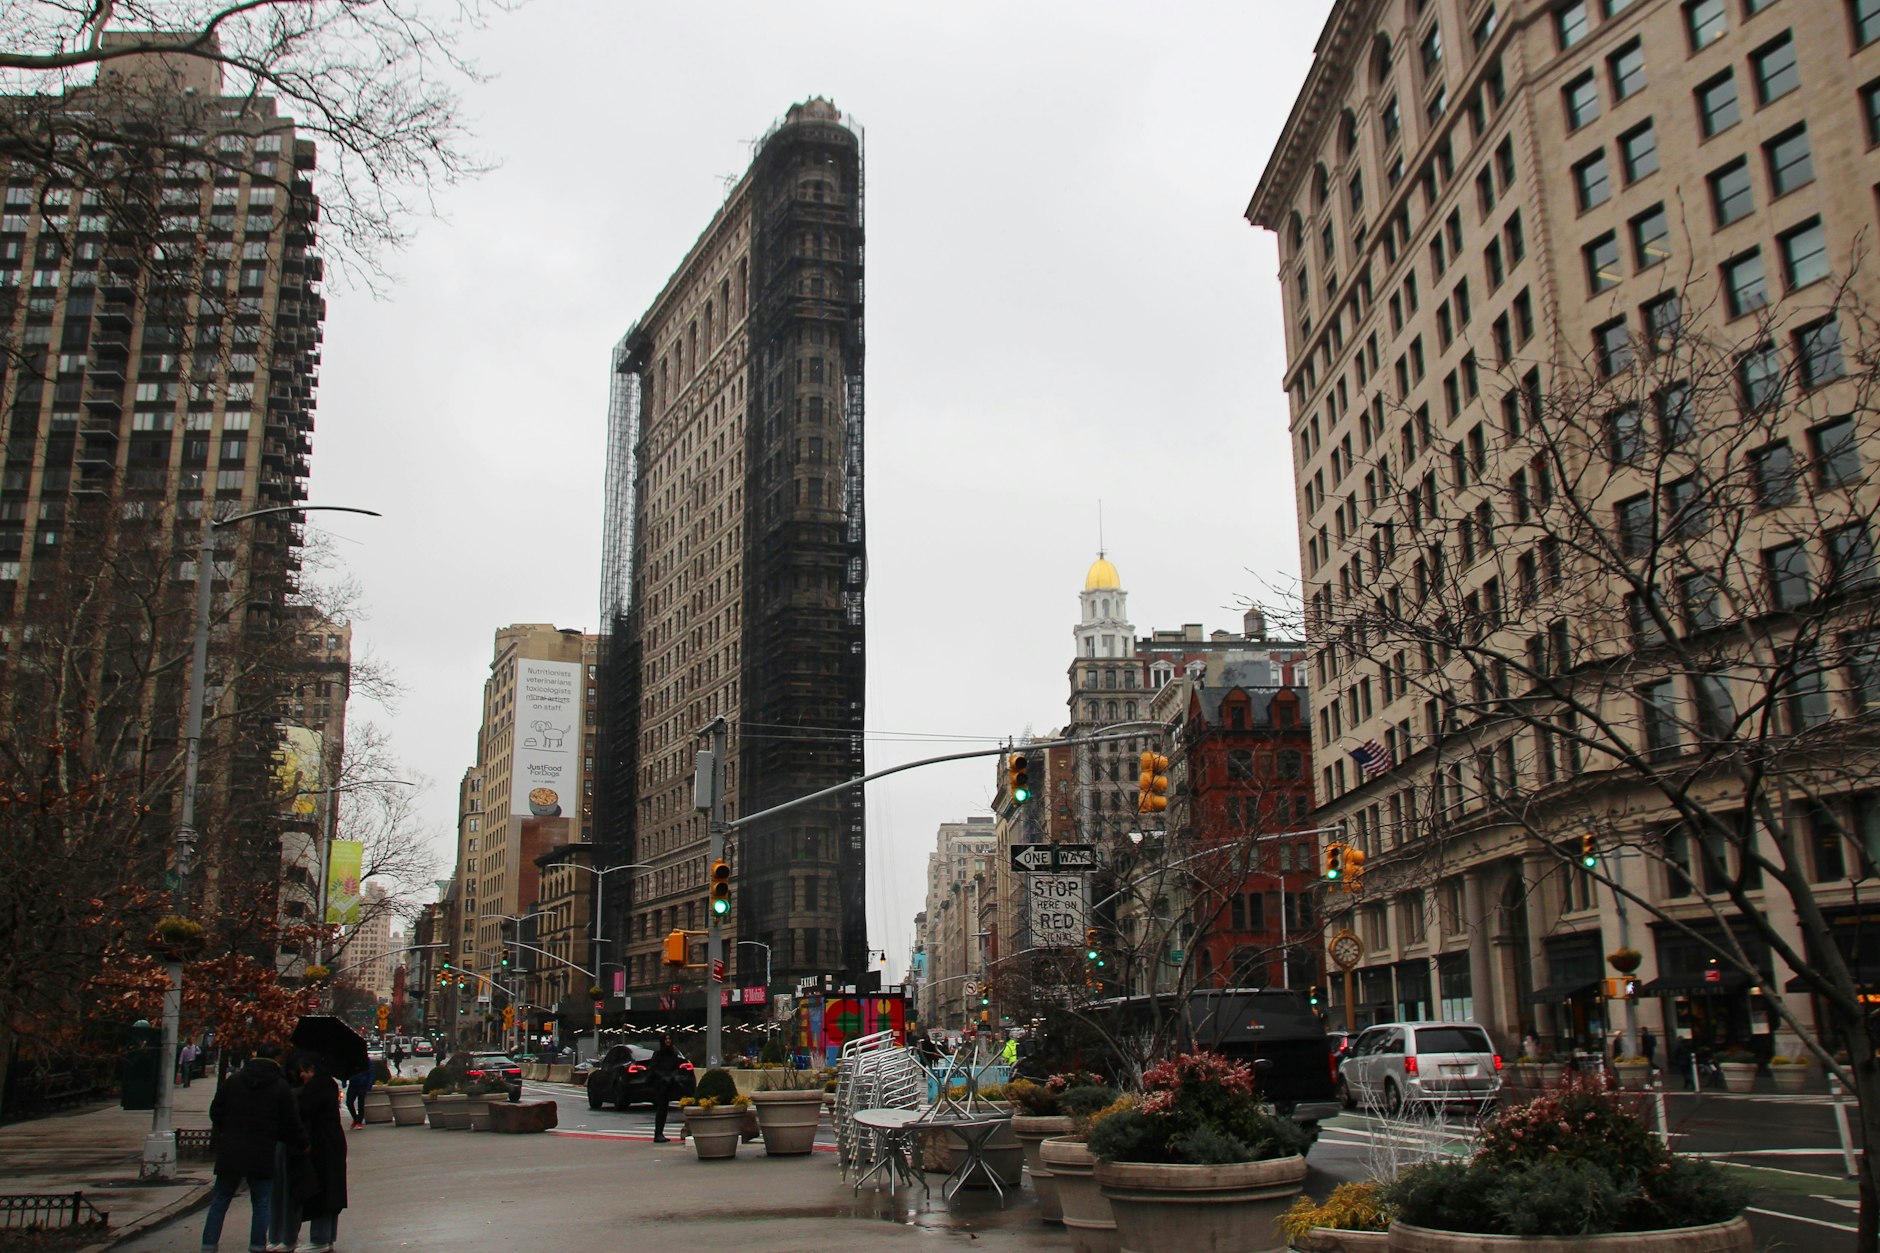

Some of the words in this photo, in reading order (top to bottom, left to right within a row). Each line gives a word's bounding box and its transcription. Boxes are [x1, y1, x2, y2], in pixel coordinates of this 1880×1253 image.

[527, 667, 571, 677] Nutritionists
[526, 677, 572, 686] veterinarians
[526, 685, 572, 695] toxicologists
[527, 763, 562, 772] JustFood
[1024, 852, 1048, 863] ONE
[1060, 851, 1086, 863] WAY
[1034, 881, 1078, 897] STOP
[1037, 901, 1060, 910] HERE
[1065, 901, 1077, 910] ON
[1040, 913, 1074, 929] RED
